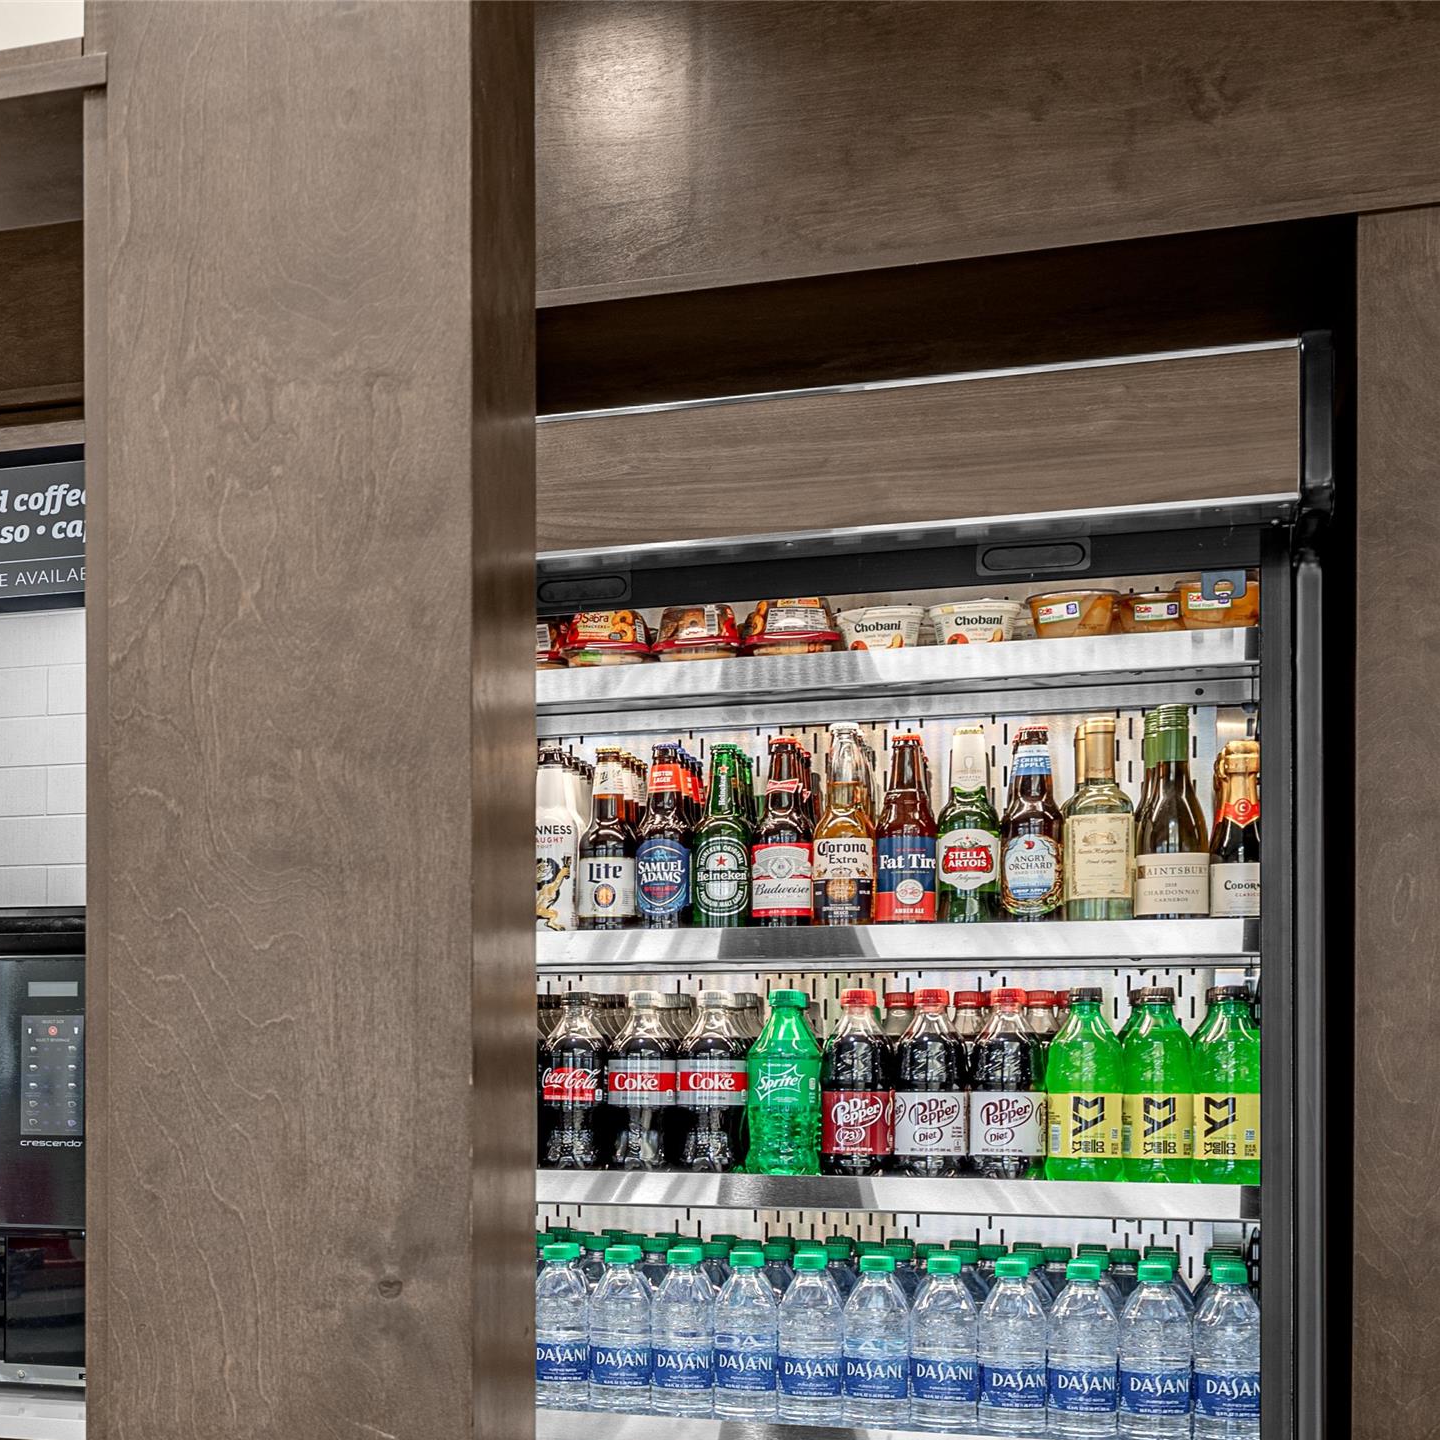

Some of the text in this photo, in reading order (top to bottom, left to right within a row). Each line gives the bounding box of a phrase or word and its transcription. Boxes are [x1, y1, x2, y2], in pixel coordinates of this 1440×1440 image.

[52, 519, 85, 543] ca
[955, 615, 1003, 626] Chobani
[855, 621, 901, 633] Chobani
[818, 841, 868, 856] Corona
[829, 855, 857, 864] Extra
[948, 851, 986, 859] STELLA
[1014, 855, 1046, 863] ANGRY
[638, 860, 684, 873] SAMUEL
[880, 855, 904, 869] Fat
[948, 858, 986, 867] ARTOIS
[1009, 862, 1052, 870] ORCHARD
[588, 863, 622, 882] Lite
[641, 872, 681, 883] ADAMS
[697, 871, 747, 881] Heineken
[755, 883, 809, 895] Budweiser
[614, 1073, 659, 1091] Coke
[689, 1072, 735, 1091] Coke
[758, 1076, 799, 1090] Sprite
[850, 1099, 869, 1110] Dr
[927, 1099, 947, 1111] Dr
[833, 1101, 880, 1124] Pepper
[910, 1102, 958, 1126] Pepper
[844, 1131, 859, 1141] 23
[918, 1131, 940, 1143] Diet
[596, 1349, 648, 1368] DASANI
[785, 1358, 838, 1377] DASANI
[847, 1359, 901, 1379] DASANI
[1130, 1372, 1189, 1394] DASANI
